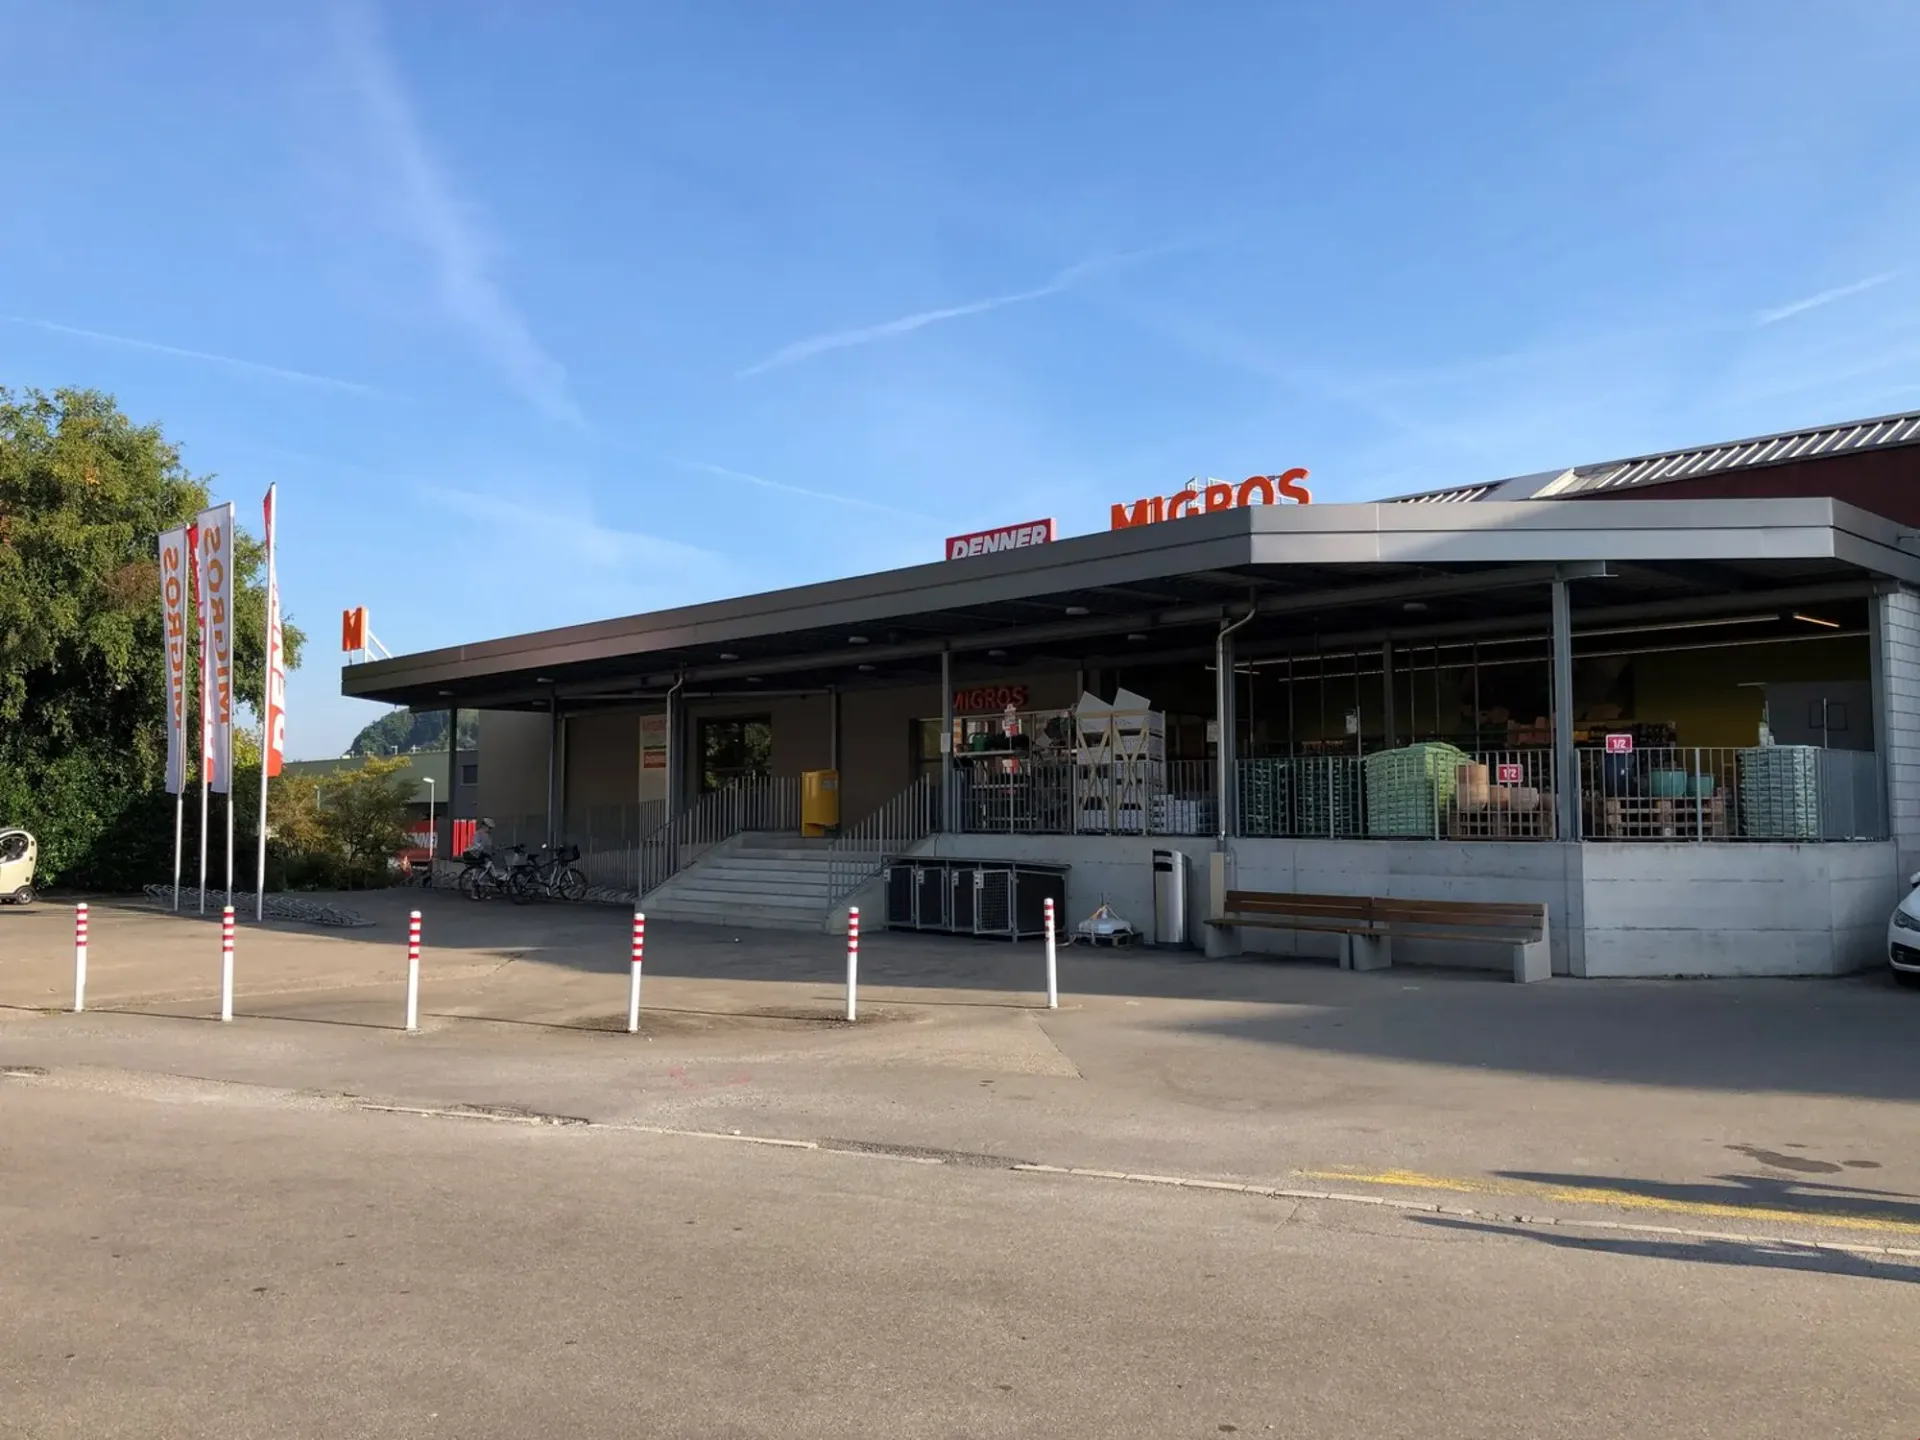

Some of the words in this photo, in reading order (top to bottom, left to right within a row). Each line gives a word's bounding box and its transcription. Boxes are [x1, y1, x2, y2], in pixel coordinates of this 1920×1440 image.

[1111, 467, 1310, 532] MIGROS
[951, 524, 1048, 560] DENNER
[343, 606, 362, 652] M
[1613, 739, 1626, 749] 1/2
